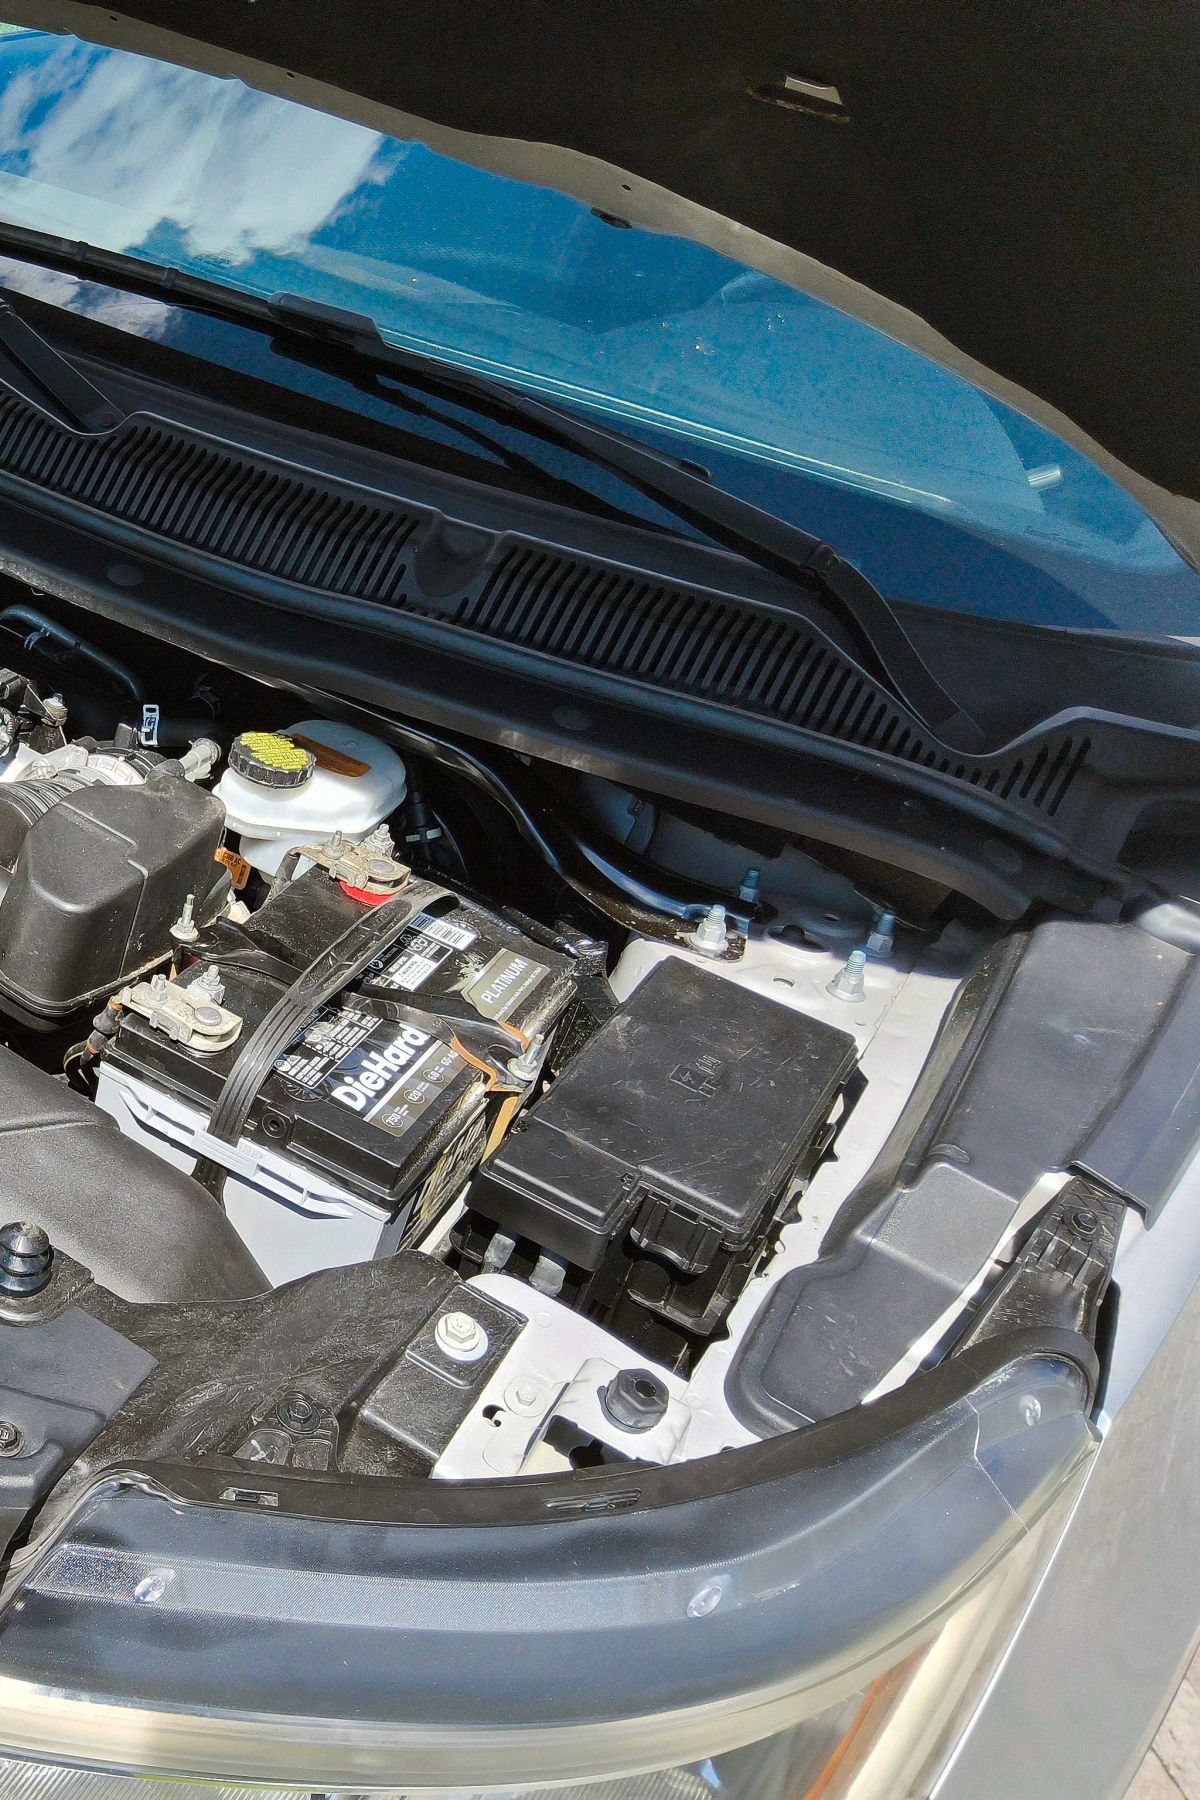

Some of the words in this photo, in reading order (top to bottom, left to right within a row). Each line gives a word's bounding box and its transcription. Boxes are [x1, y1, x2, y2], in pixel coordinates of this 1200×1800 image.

[481, 958, 529, 1004] PLATINUM
[331, 1023, 432, 1111] DieHard
[386, 1113, 401, 1126] 750
[407, 1090, 422, 1101] 120
